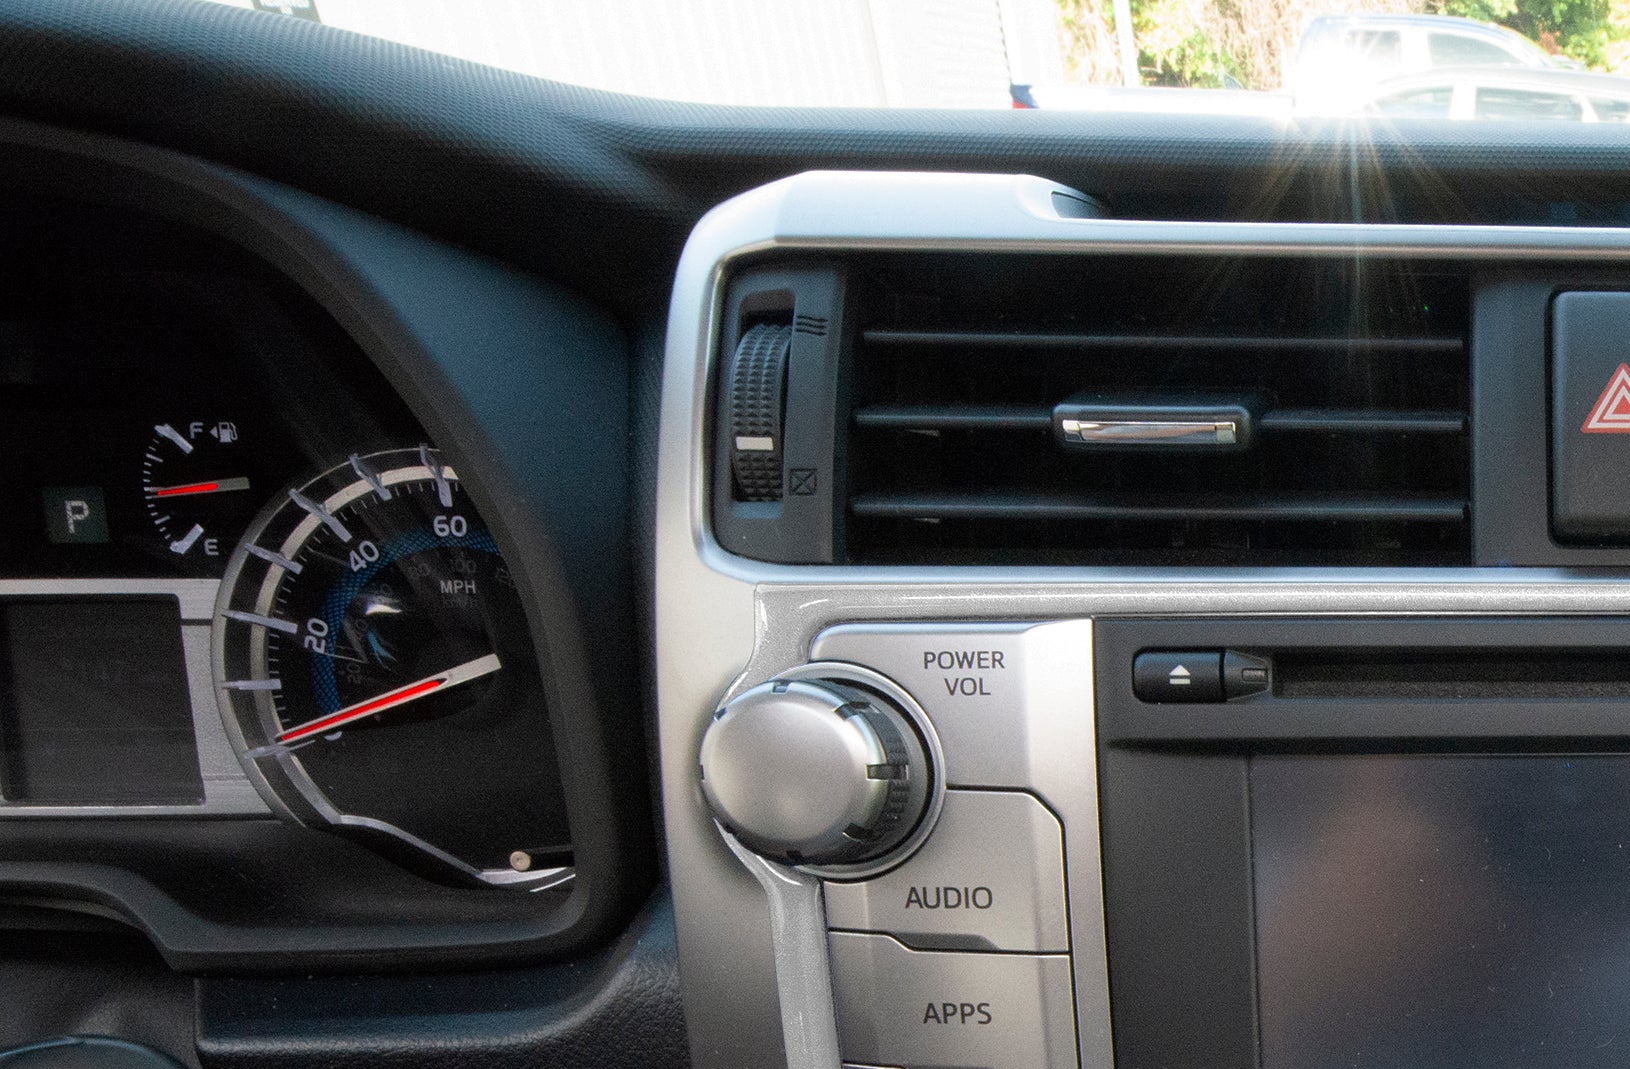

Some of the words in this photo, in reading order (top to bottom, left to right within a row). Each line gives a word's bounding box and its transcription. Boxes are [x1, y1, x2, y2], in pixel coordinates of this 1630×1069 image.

[190, 423, 203, 439] F
[65, 500, 89, 533] P
[433, 515, 468, 537] 60
[204, 539, 219, 556] E
[349, 540, 380, 573] 40
[439, 579, 477, 594] MPH
[303, 617, 329, 654] 20
[923, 650, 1006, 671] POWER
[944, 676, 992, 698] VOL
[904, 886, 994, 911] AUDIO
[922, 1001, 993, 1026] APPS
